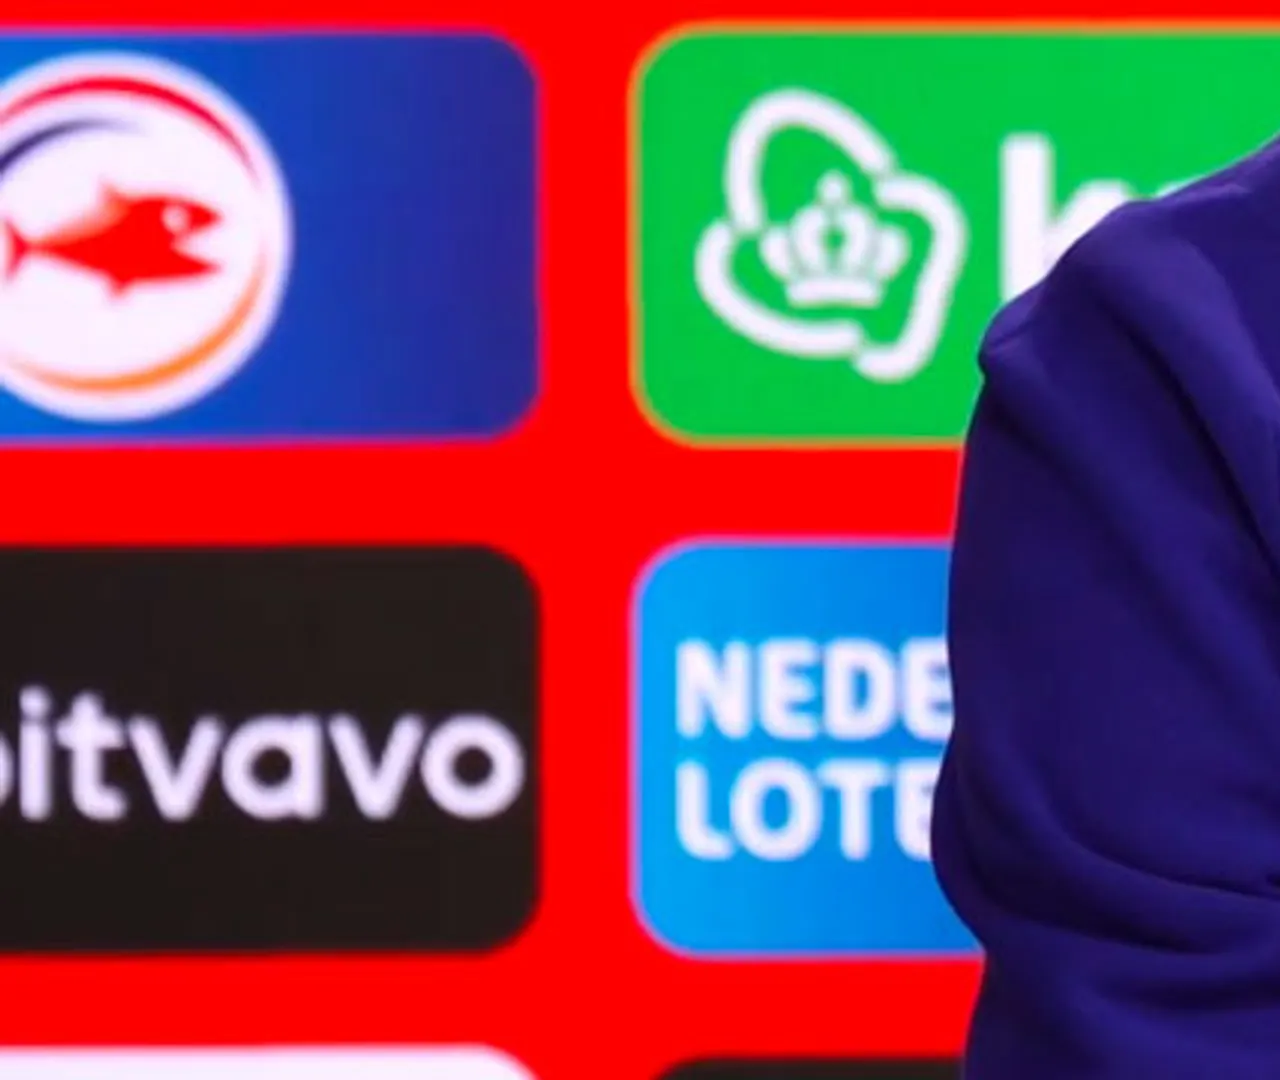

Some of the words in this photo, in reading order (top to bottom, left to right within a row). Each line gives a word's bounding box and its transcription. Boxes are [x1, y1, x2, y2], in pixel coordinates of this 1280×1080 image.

[675, 636, 953, 742] NEDE
[0, 685, 524, 821] itvavo
[675, 758, 941, 862] LOTE
